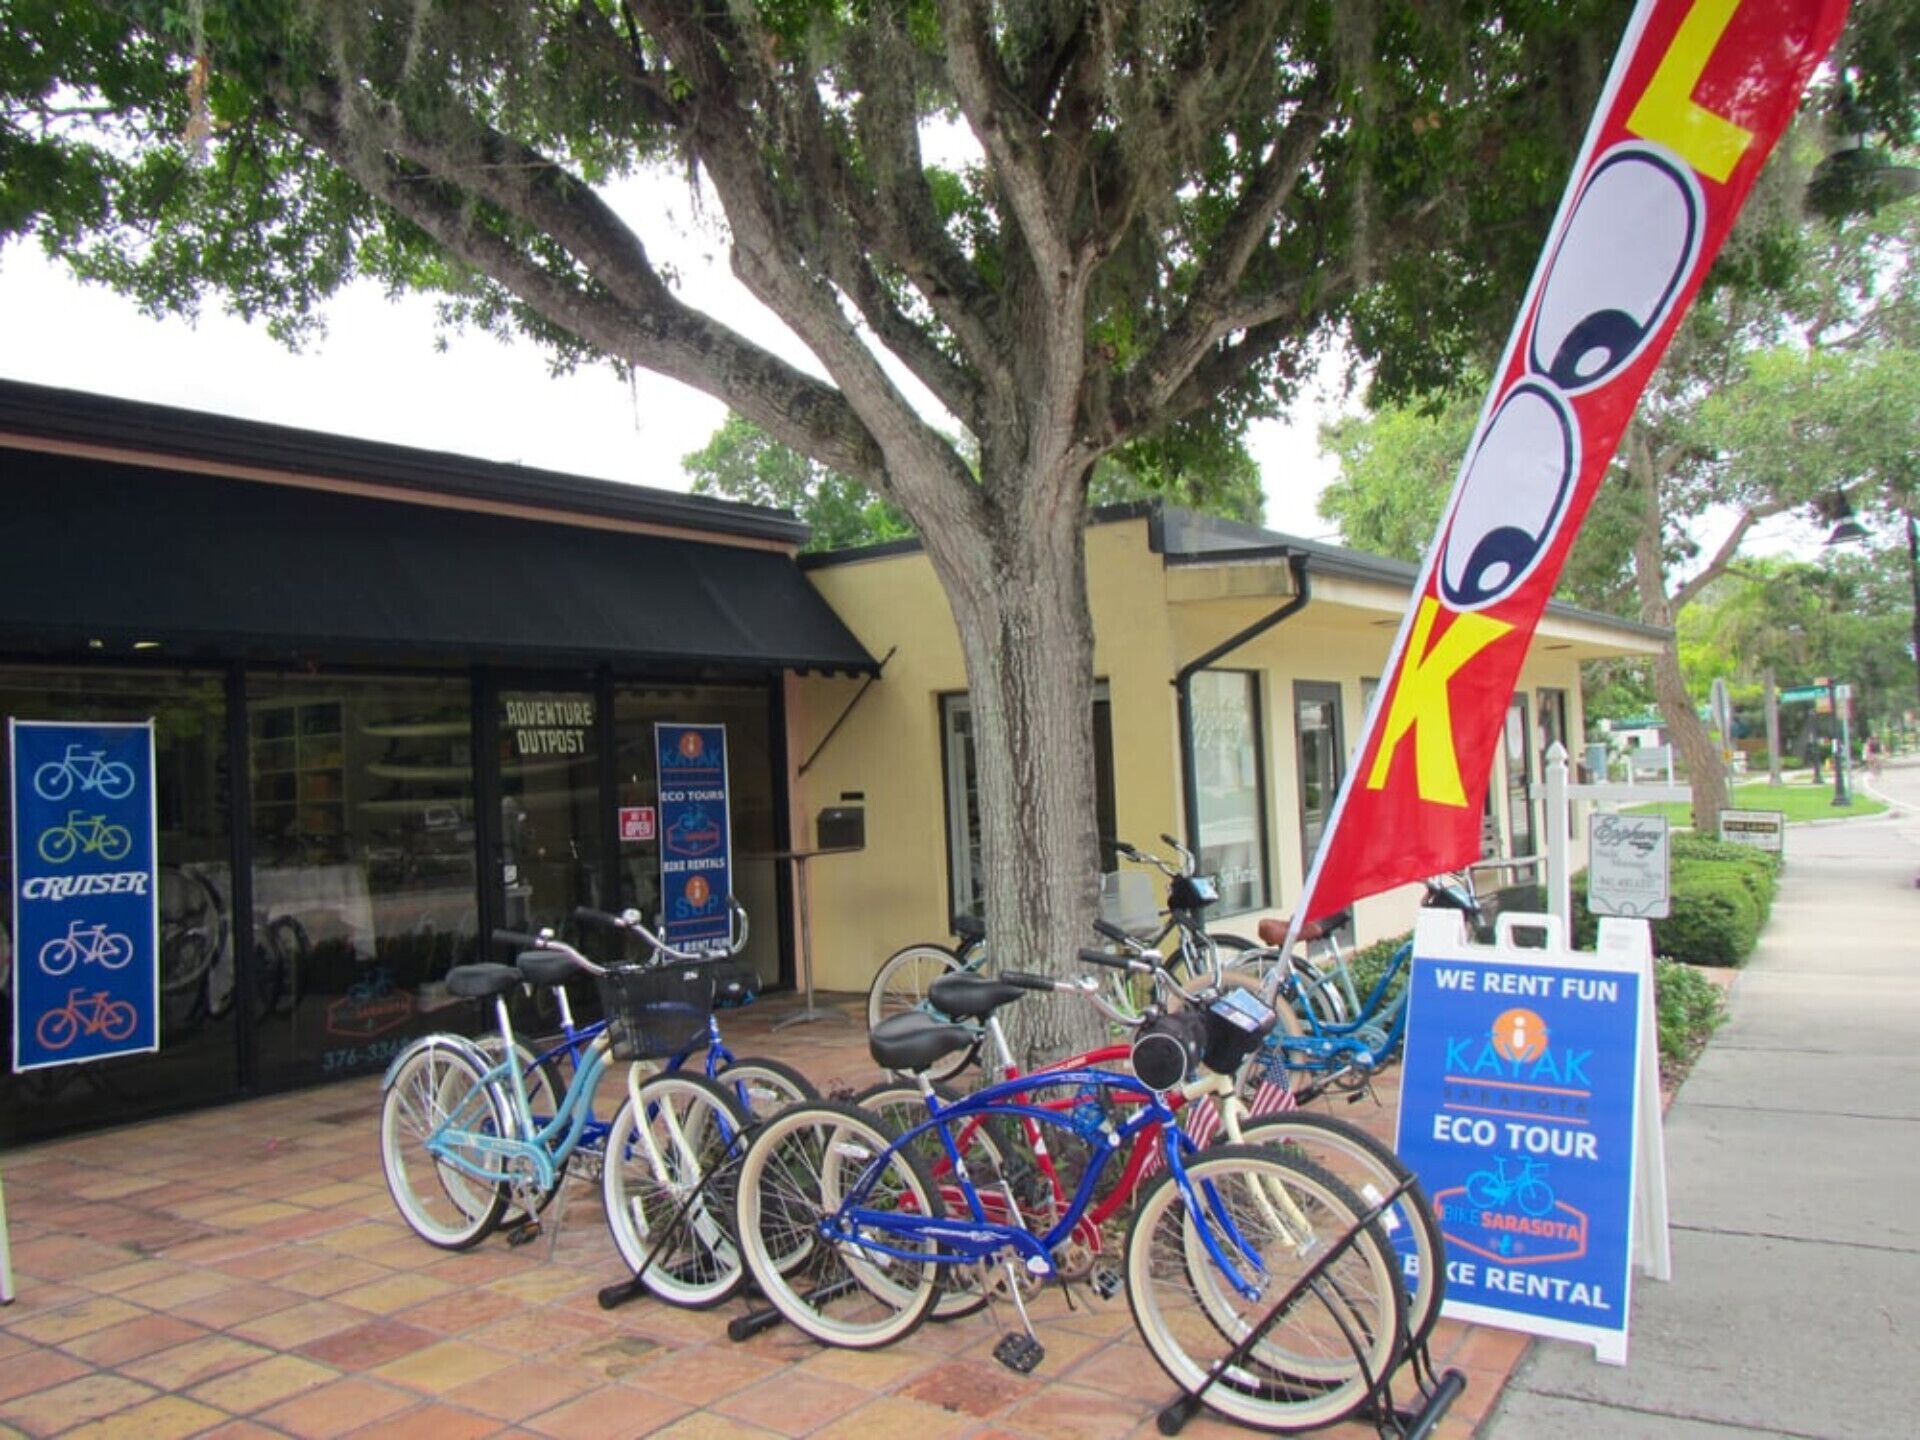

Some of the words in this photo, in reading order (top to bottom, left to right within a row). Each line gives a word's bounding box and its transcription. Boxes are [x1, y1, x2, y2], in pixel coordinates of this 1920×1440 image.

[505, 701, 593, 726] ADVENTURE
[518, 728, 585, 754] OUTPOST
[661, 790, 685, 802] ECO
[687, 789, 725, 801] TOURS
[22, 871, 149, 901] CRUISER
[1435, 968, 1476, 992] WE
[1483, 972, 1554, 998] RENT
[1562, 977, 1618, 1003] FUN
[1444, 1035, 1595, 1086] KAYAK
[1432, 1113, 1497, 1147] ECO
[1505, 1122, 1600, 1162] TOUR
[1481, 1211, 1581, 1243] SARASOTA
[1404, 1253, 1477, 1287] BKE
[1486, 1266, 1612, 1311] RENTAL
